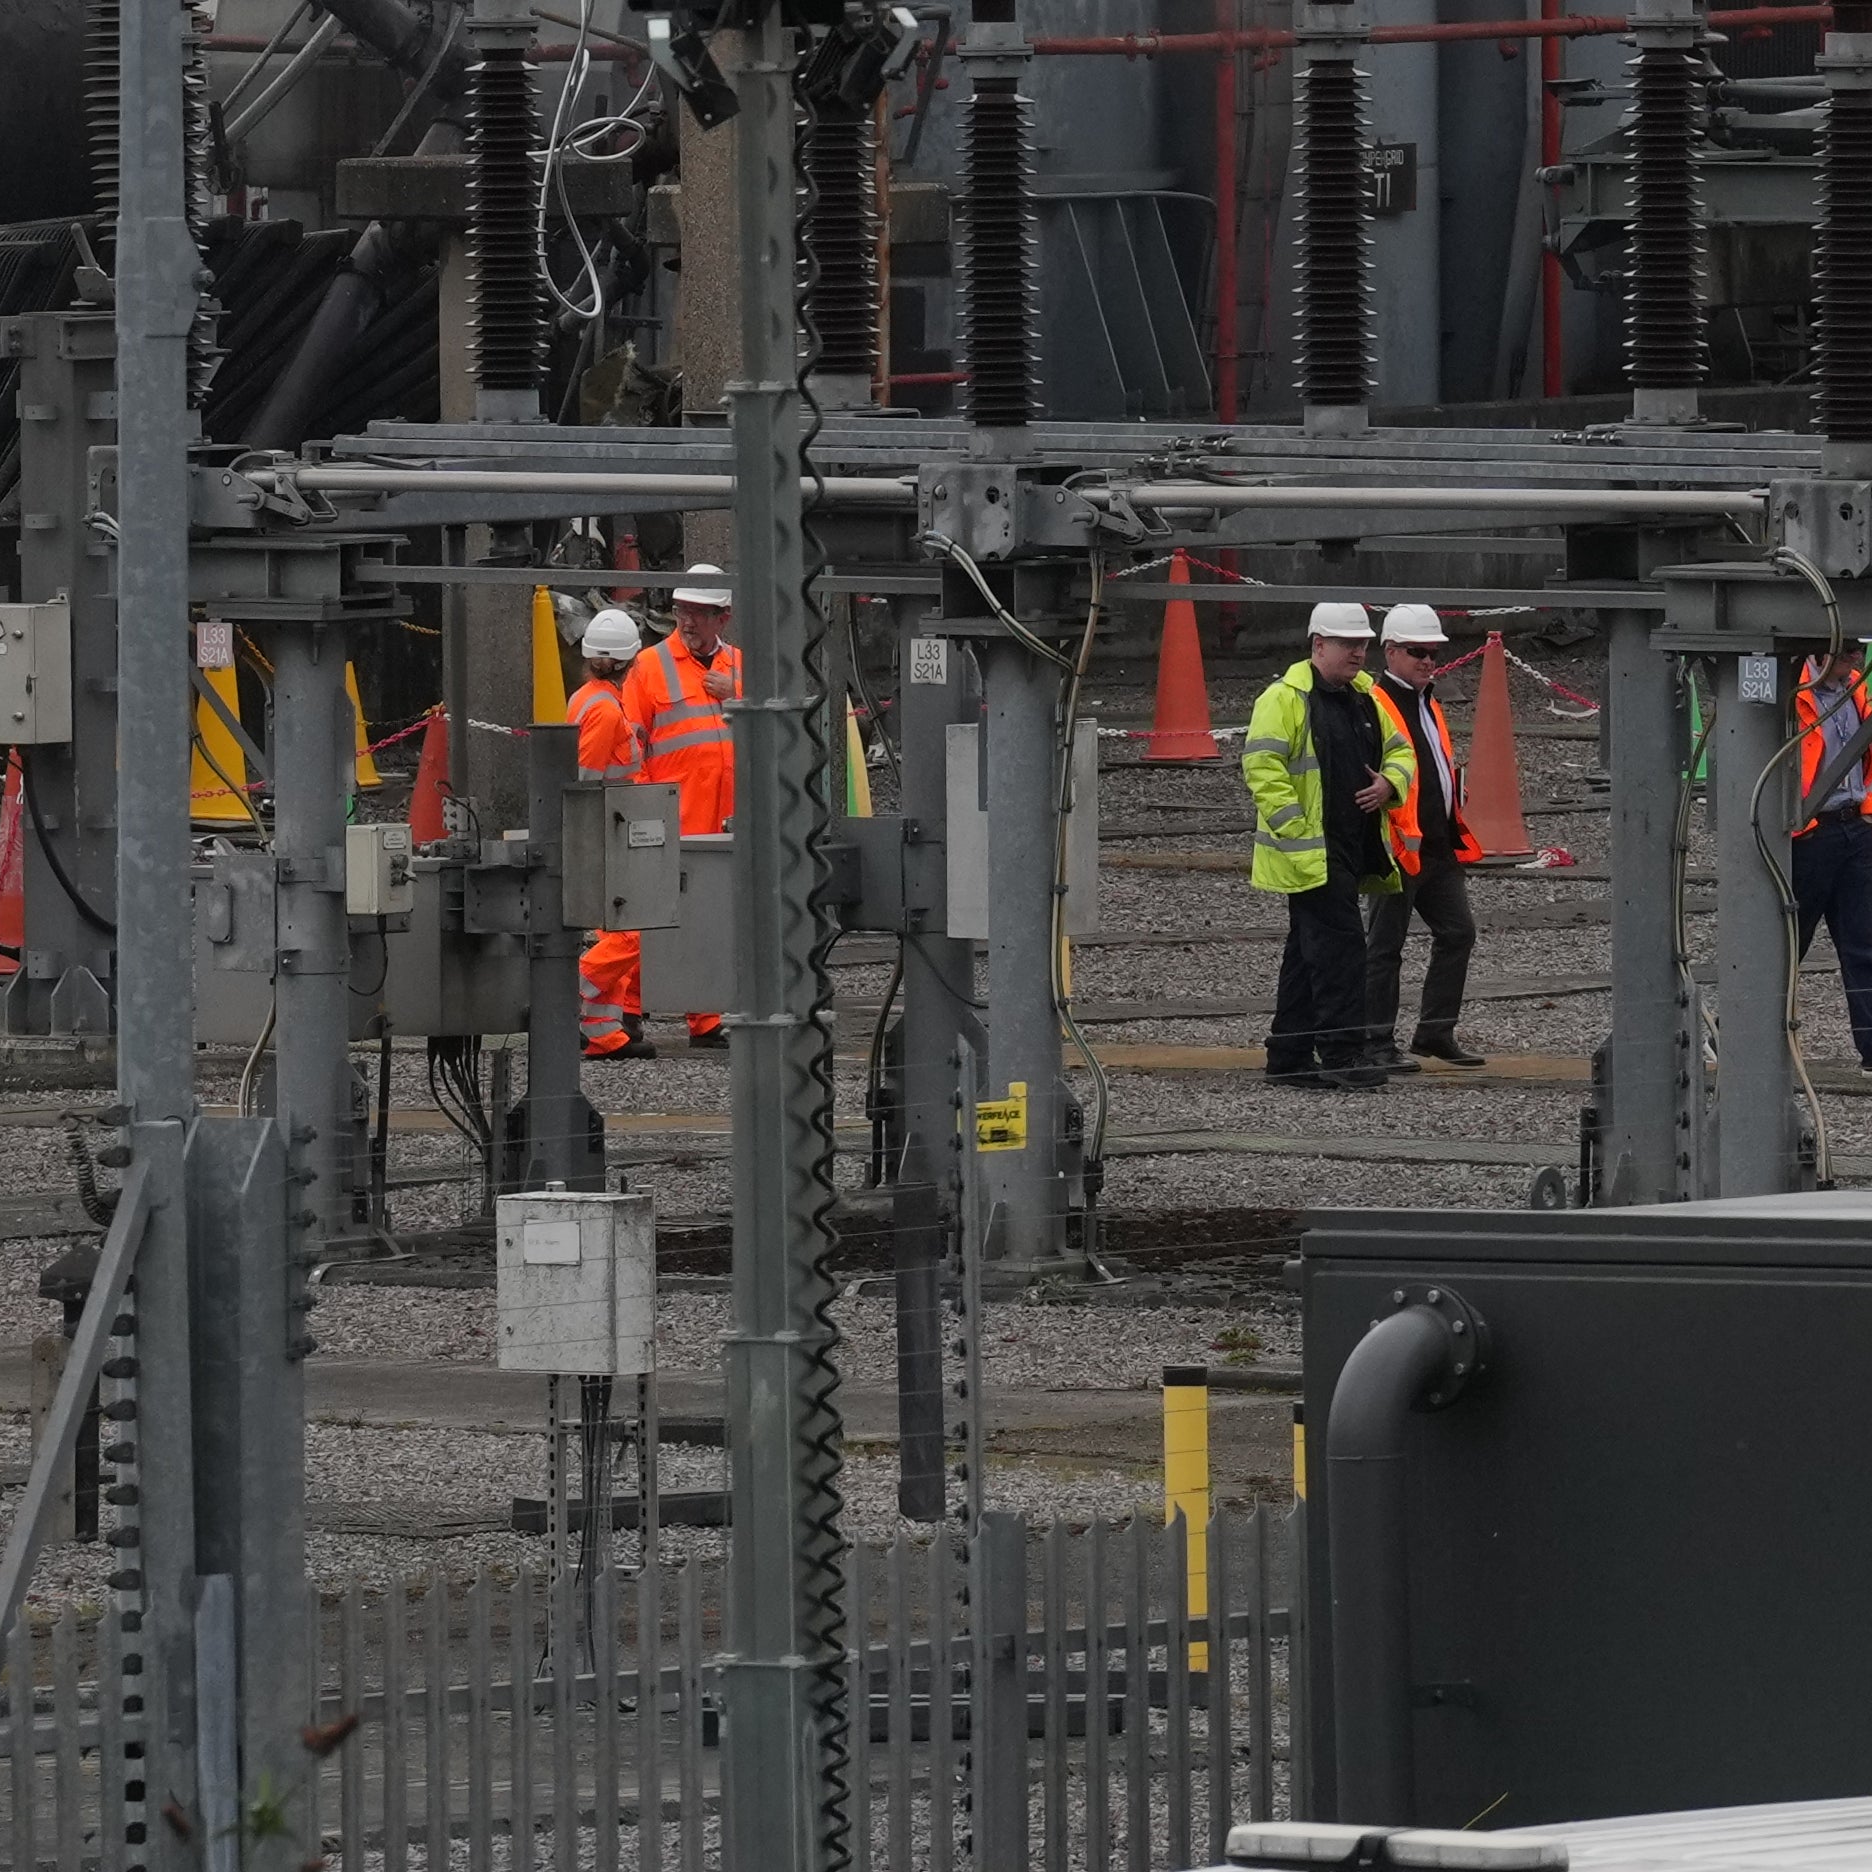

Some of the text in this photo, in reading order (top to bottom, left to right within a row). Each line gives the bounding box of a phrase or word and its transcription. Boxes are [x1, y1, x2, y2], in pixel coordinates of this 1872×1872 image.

[203, 628, 226, 644] L33
[200, 646, 229, 664] S21A
[917, 643, 941, 660] L33
[914, 662, 944, 680] S21A
[1745, 660, 1770, 679] L33
[1741, 680, 1773, 699] S21A
